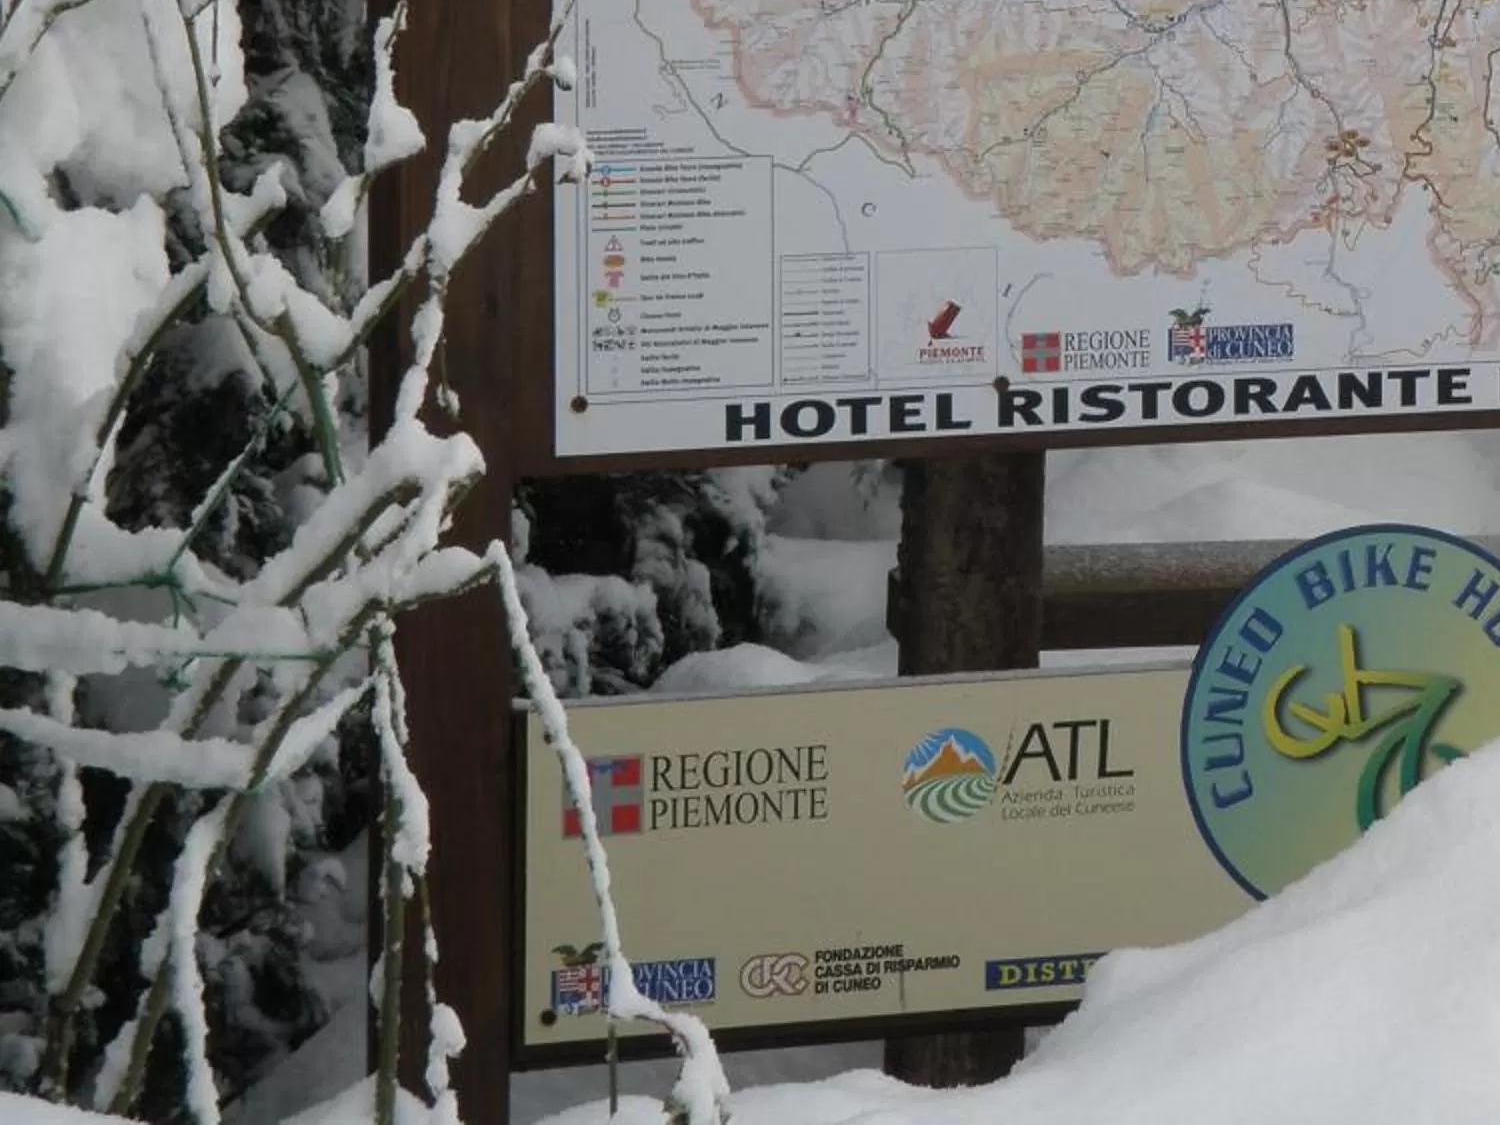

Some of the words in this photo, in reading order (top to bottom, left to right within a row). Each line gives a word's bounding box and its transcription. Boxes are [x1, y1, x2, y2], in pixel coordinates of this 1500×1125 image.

[1064, 329, 1151, 352] REGIONE
[1208, 325, 1293, 342] PROVINCIA
[919, 346, 985, 360] PIEMONTE
[1225, 339, 1294, 358] CUNEO
[1064, 351, 1151, 371] PIEMONTE
[725, 392, 972, 442] HOTEL
[997, 367, 1473, 428] RISTORANTE
[1201, 607, 1284, 810] CUNEO
[1295, 542, 1438, 611] BIKE
[1002, 718, 1136, 785] ATL
[650, 744, 829, 792] REGIONE
[1001, 788, 1063, 805] Azienda
[1075, 784, 1136, 800] Turistica
[650, 786, 829, 831] PIEMONTE
[1001, 805, 1047, 821] Locale
[1050, 803, 1071, 817] del
[1075, 801, 1136, 816] Cuneese
[815, 943, 905, 964] FONDAZIONE
[815, 963, 863, 980] CASSA
[866, 961, 881, 976] DI
[884, 955, 962, 974] RISPARMIO
[637, 976, 714, 1003] UNEO
[815, 980, 829, 995] DI
[832, 977, 882, 993] CUNEO
